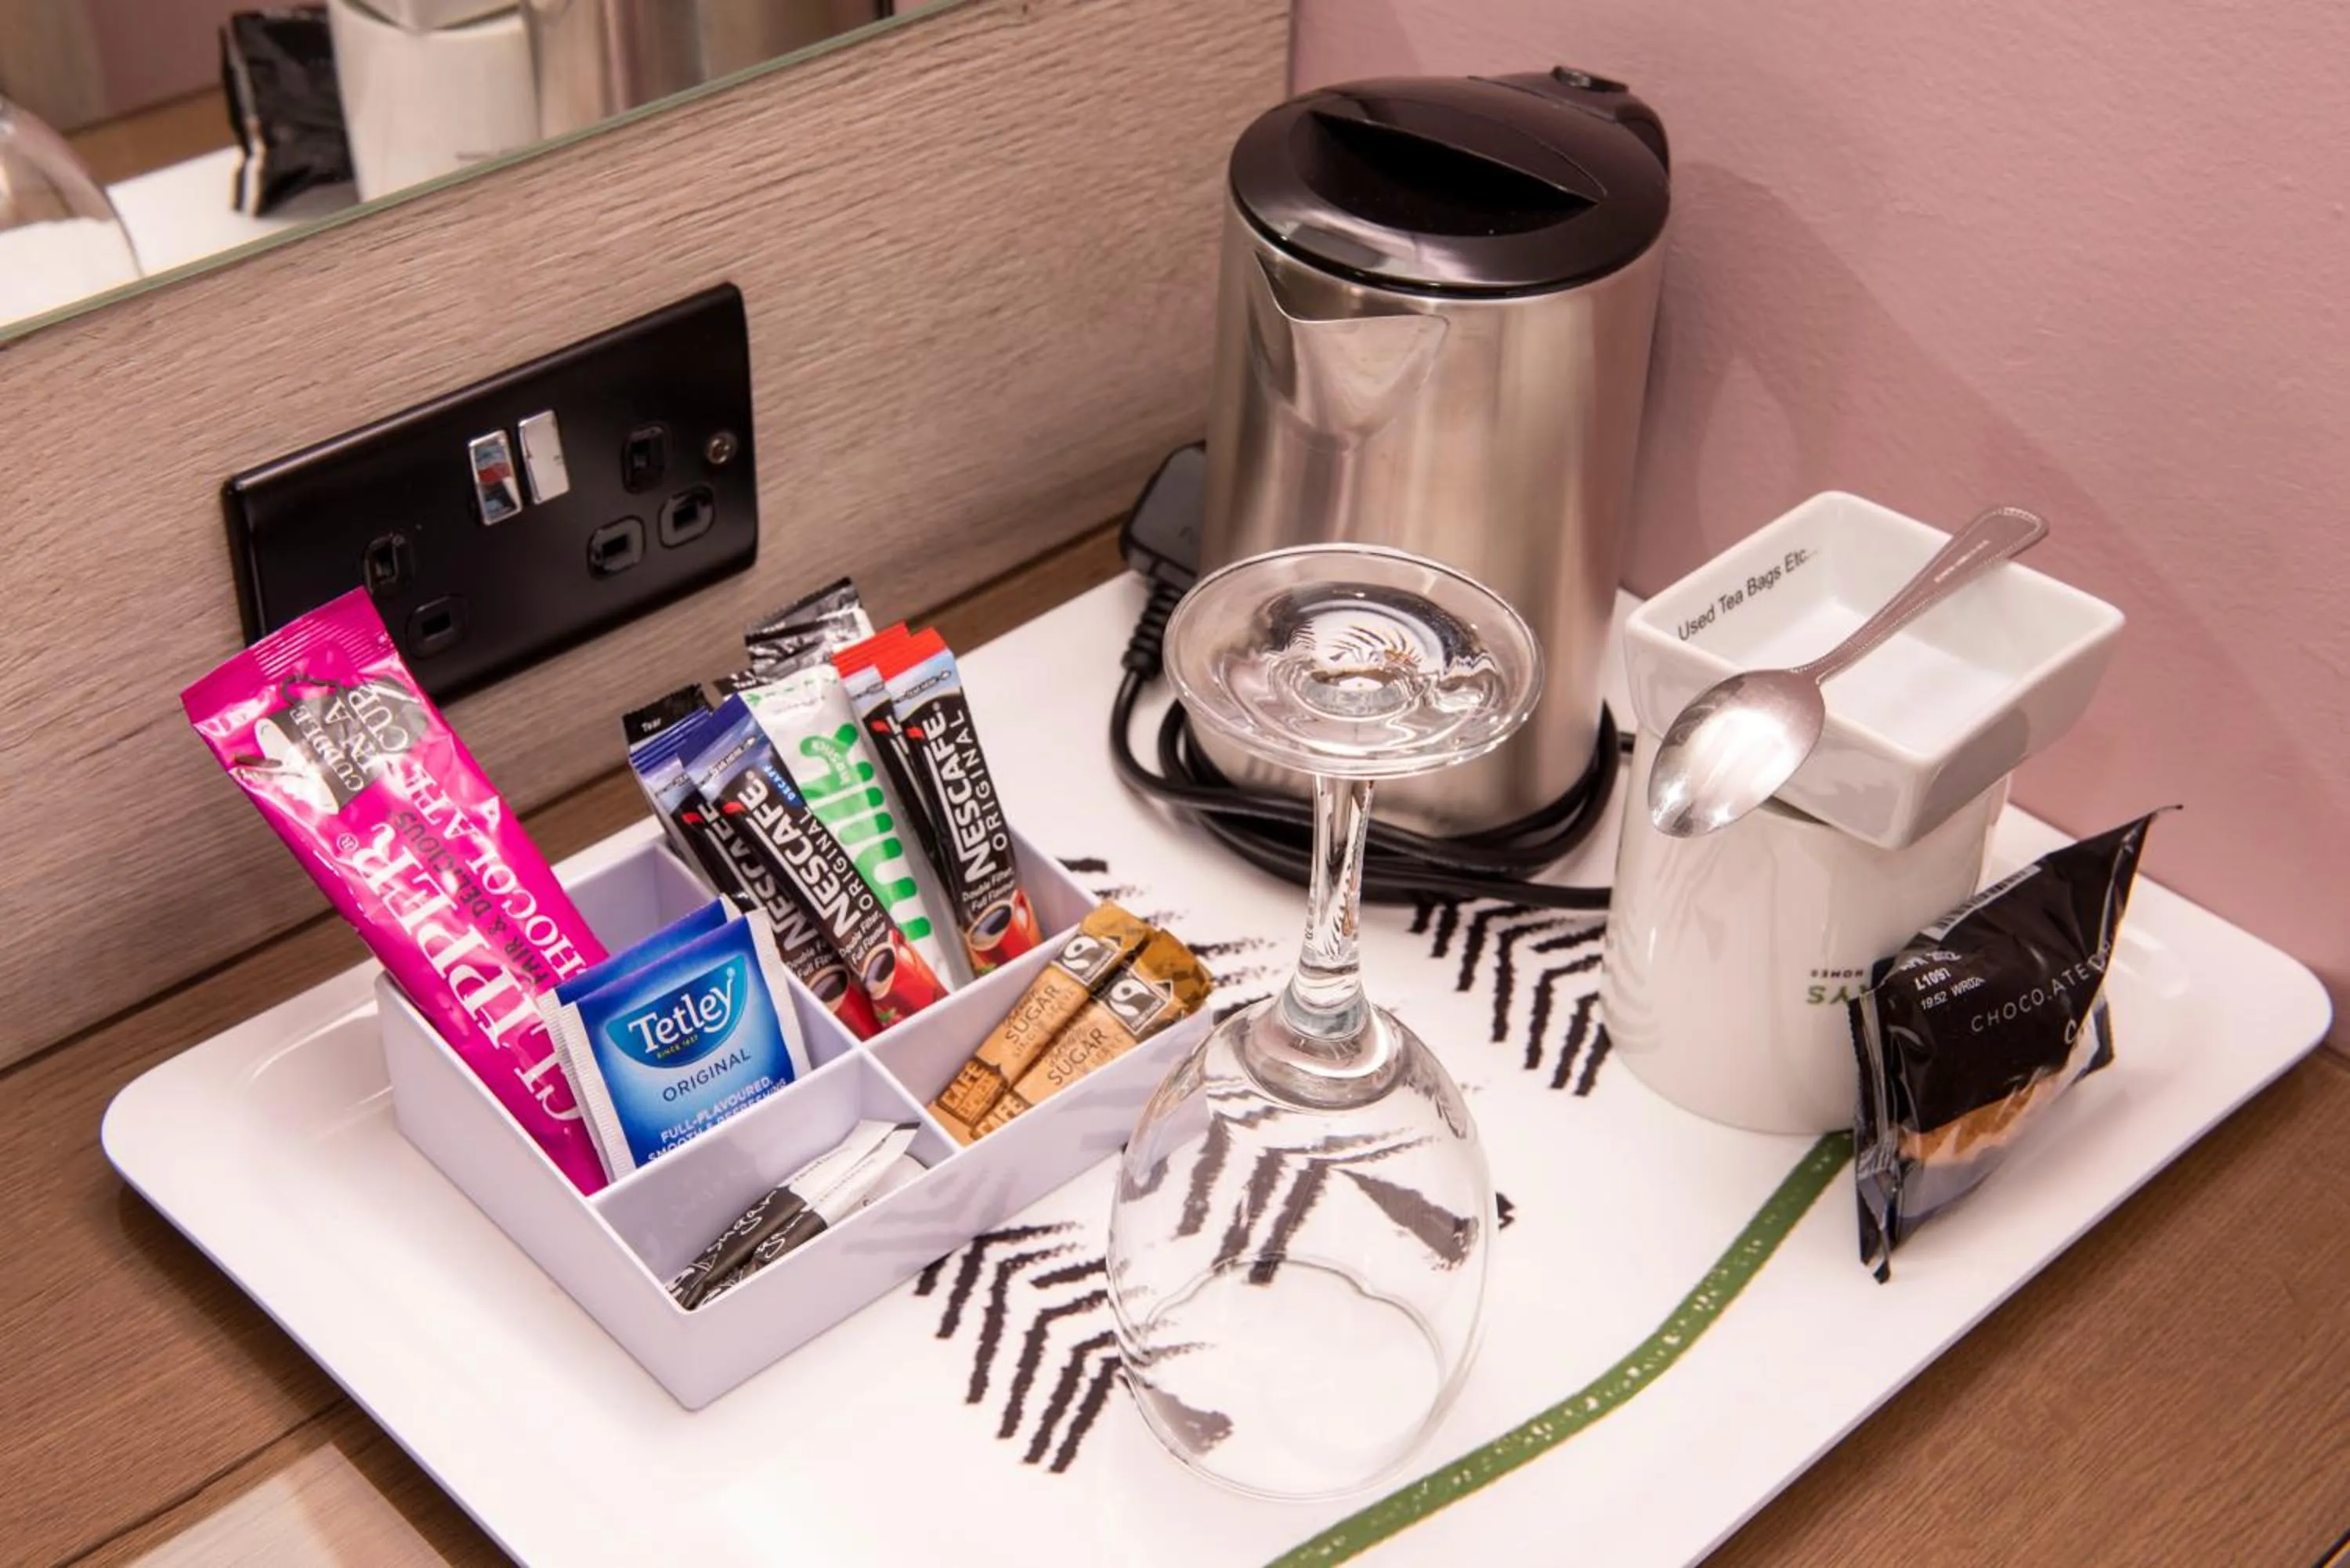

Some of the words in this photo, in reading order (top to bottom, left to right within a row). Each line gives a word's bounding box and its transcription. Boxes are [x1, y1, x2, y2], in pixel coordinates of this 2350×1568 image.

[1678, 603, 1716, 641] Used
[1718, 589, 1744, 615] Tea
[1746, 565, 1781, 598] Bags
[325, 695, 353, 724] A
[349, 689, 408, 752] CUP
[949, 709, 1008, 851] ORIGINAL
[799, 805, 874, 911] ORIGINAL
[800, 722, 934, 941] milk
[487, 917, 509, 937] &
[627, 966, 735, 1054] Tetley
[1004, 984, 1061, 1043] SUGAR
[662, 1047, 752, 1102] ORIGINAL
[1047, 1027, 1108, 1086] SUGAR
